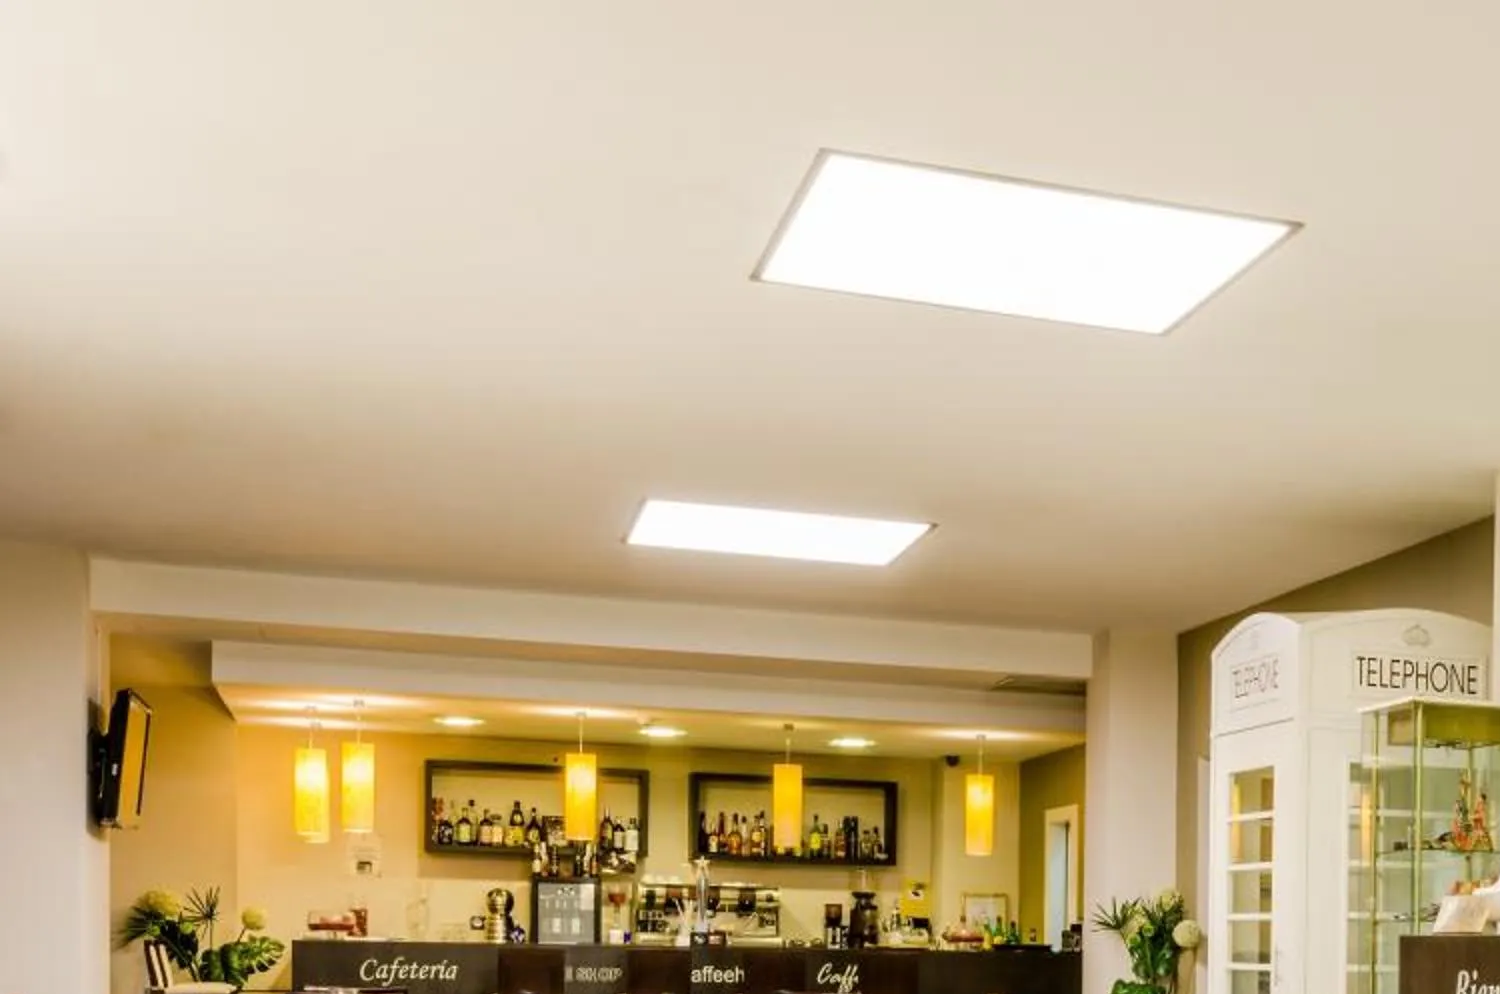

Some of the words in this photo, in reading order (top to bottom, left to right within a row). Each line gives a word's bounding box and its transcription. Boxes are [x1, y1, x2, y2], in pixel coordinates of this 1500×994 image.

[1231, 658, 1279, 699] TELEPHONE
[1356, 655, 1478, 695] TELEPHONE
[359, 956, 459, 987] Cafetería
[690, 964, 745, 984] affeeh
